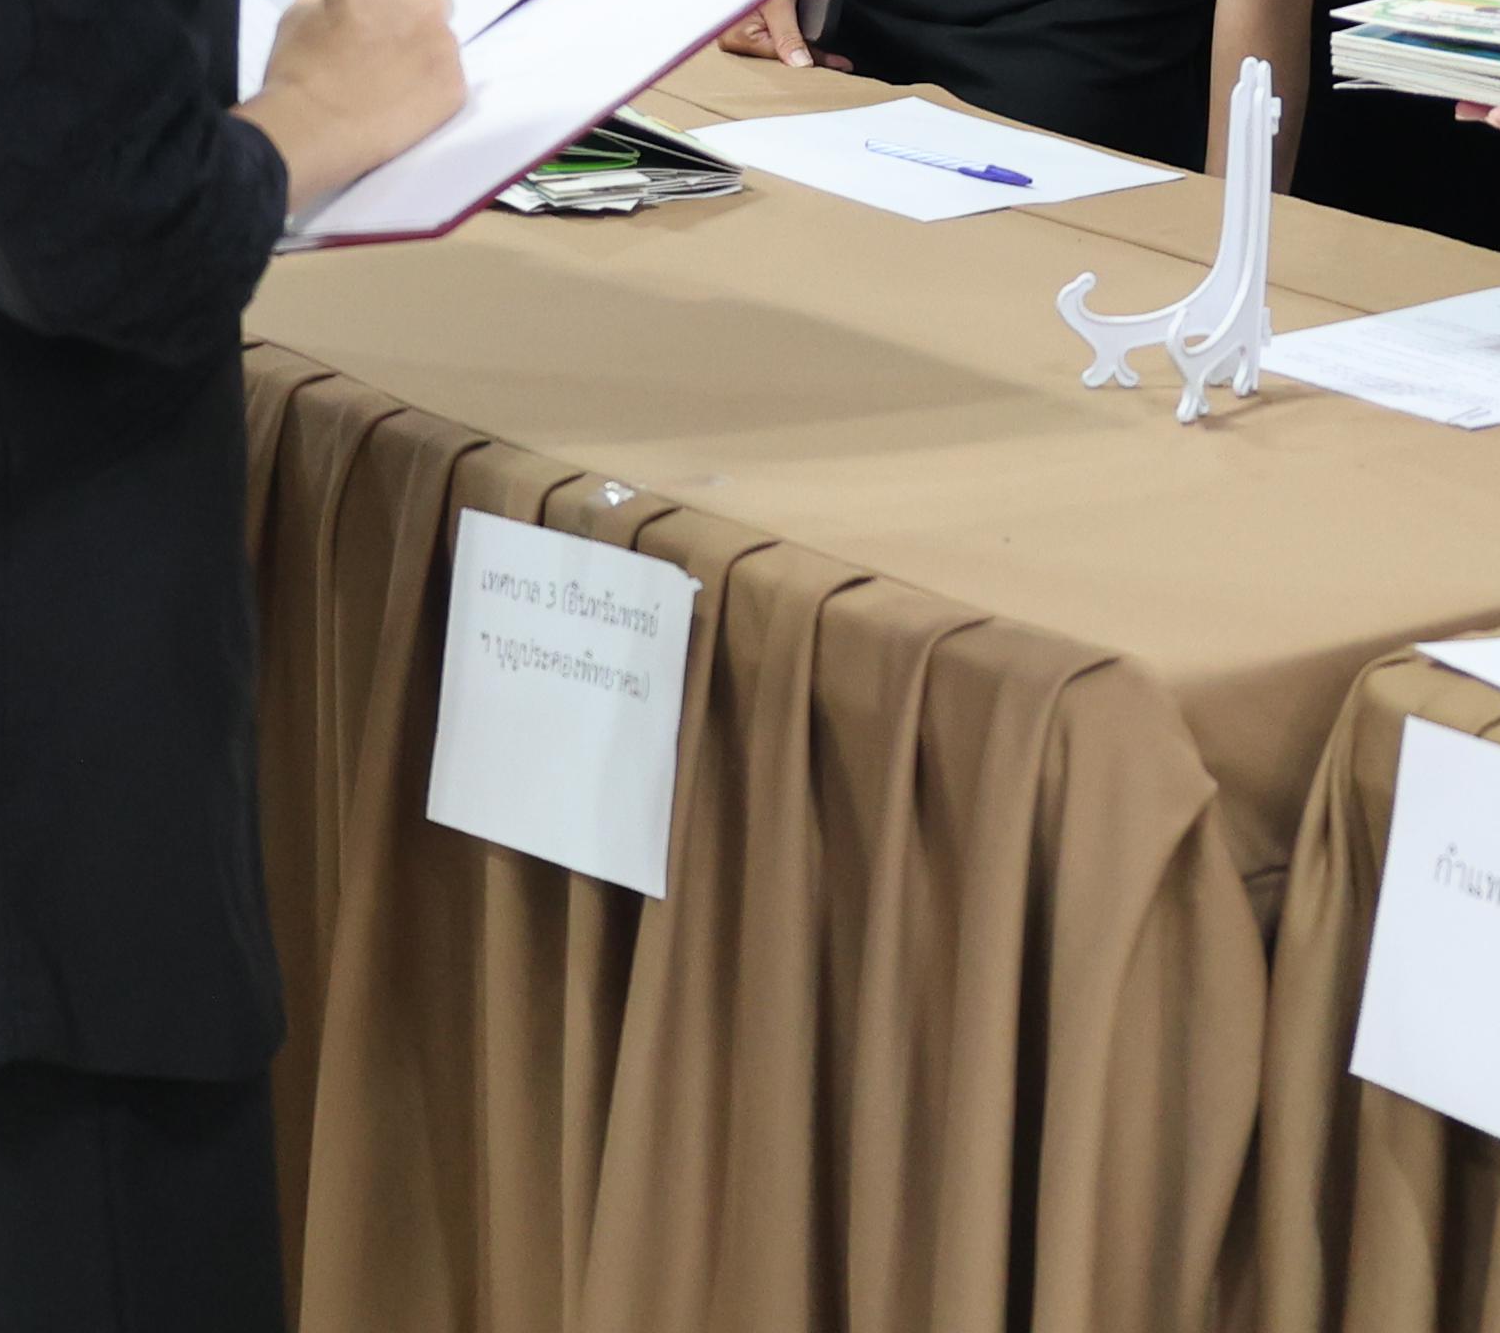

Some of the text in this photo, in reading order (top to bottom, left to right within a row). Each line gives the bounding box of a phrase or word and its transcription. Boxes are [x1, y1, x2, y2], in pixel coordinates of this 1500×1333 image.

[481, 570, 541, 605] เทศบาล
[546, 582, 557, 609] 3
